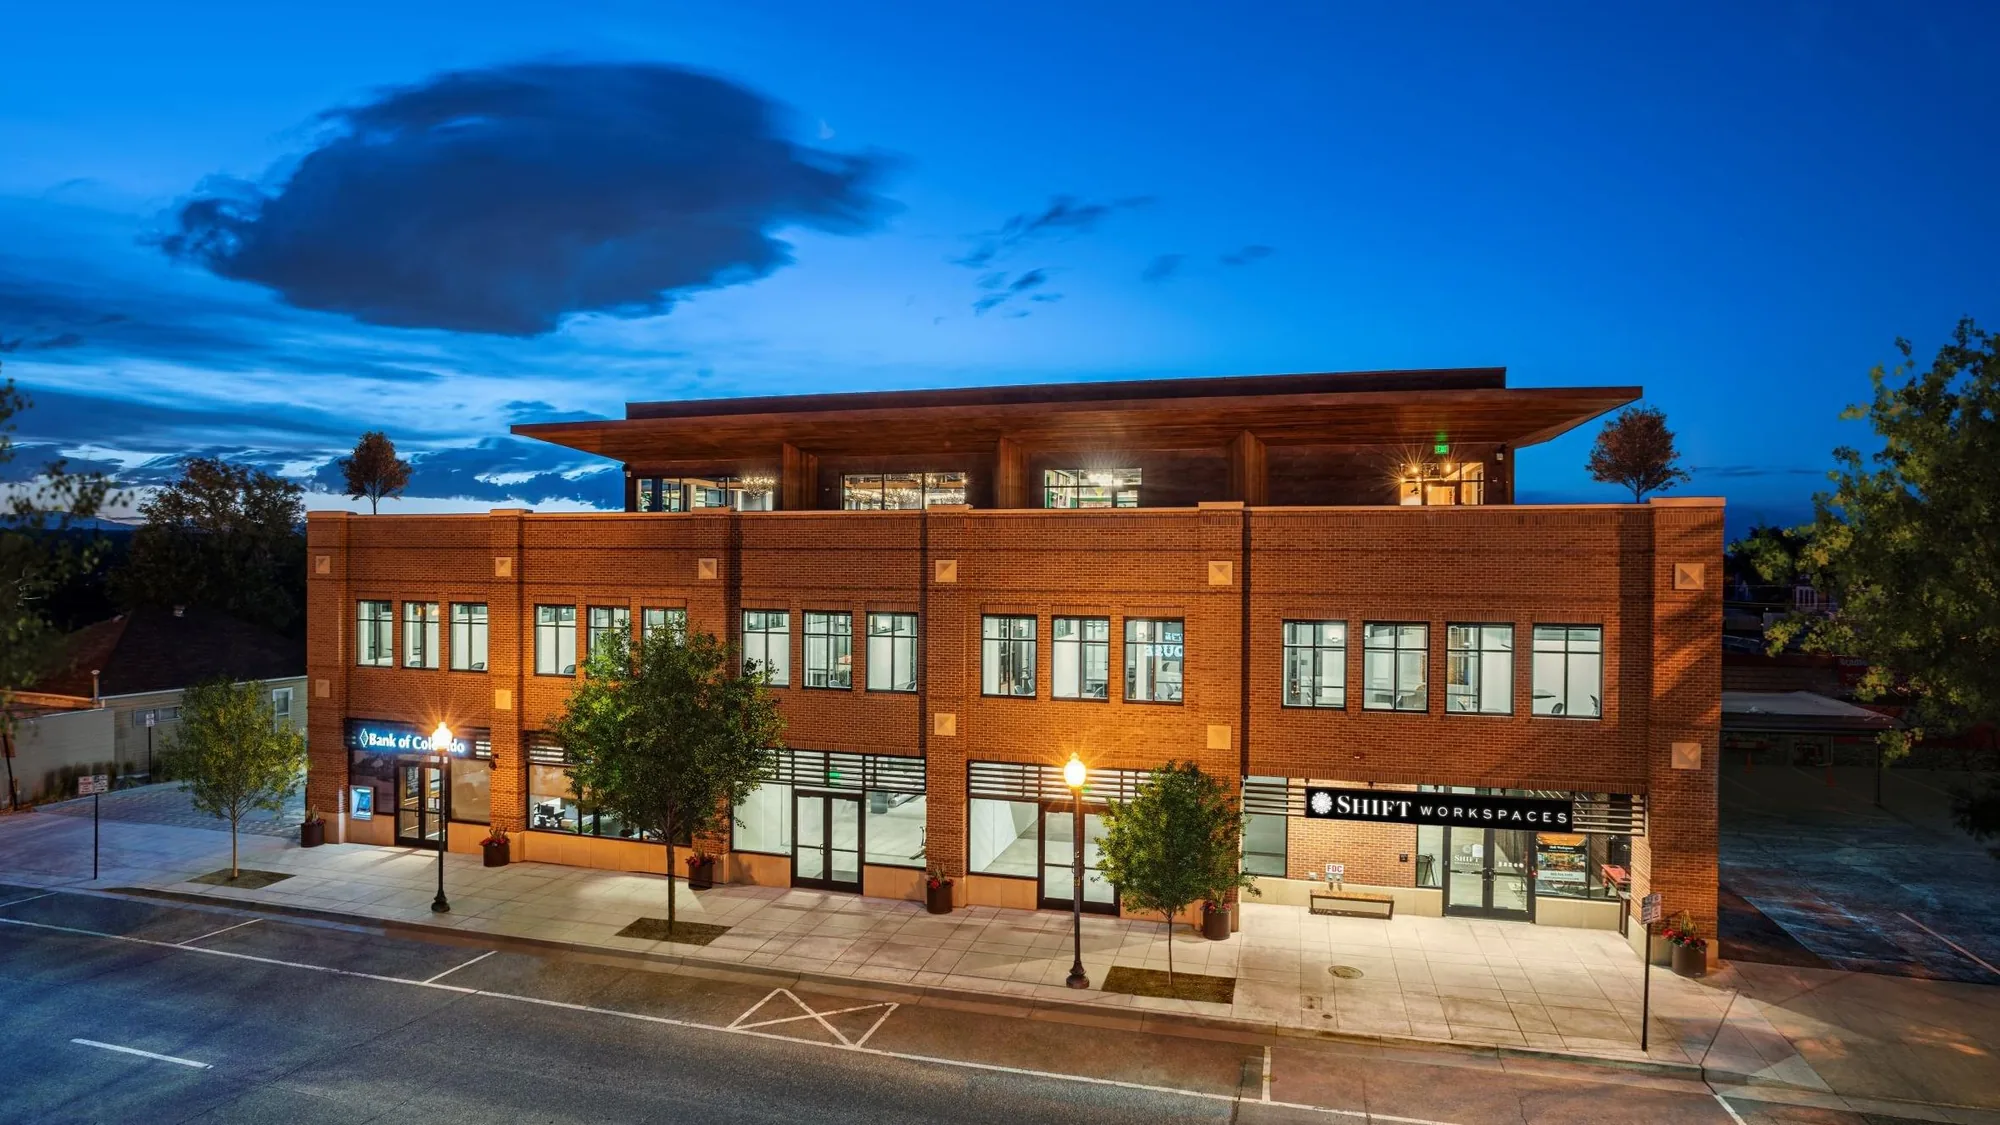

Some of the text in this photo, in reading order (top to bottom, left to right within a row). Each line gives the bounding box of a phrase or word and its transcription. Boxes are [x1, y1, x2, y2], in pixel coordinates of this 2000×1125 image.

[369, 732, 465, 753] Bank of Coldo
[1337, 795, 1568, 824] SHIFT WORKSPACES
[1327, 864, 1343, 873] FDC
